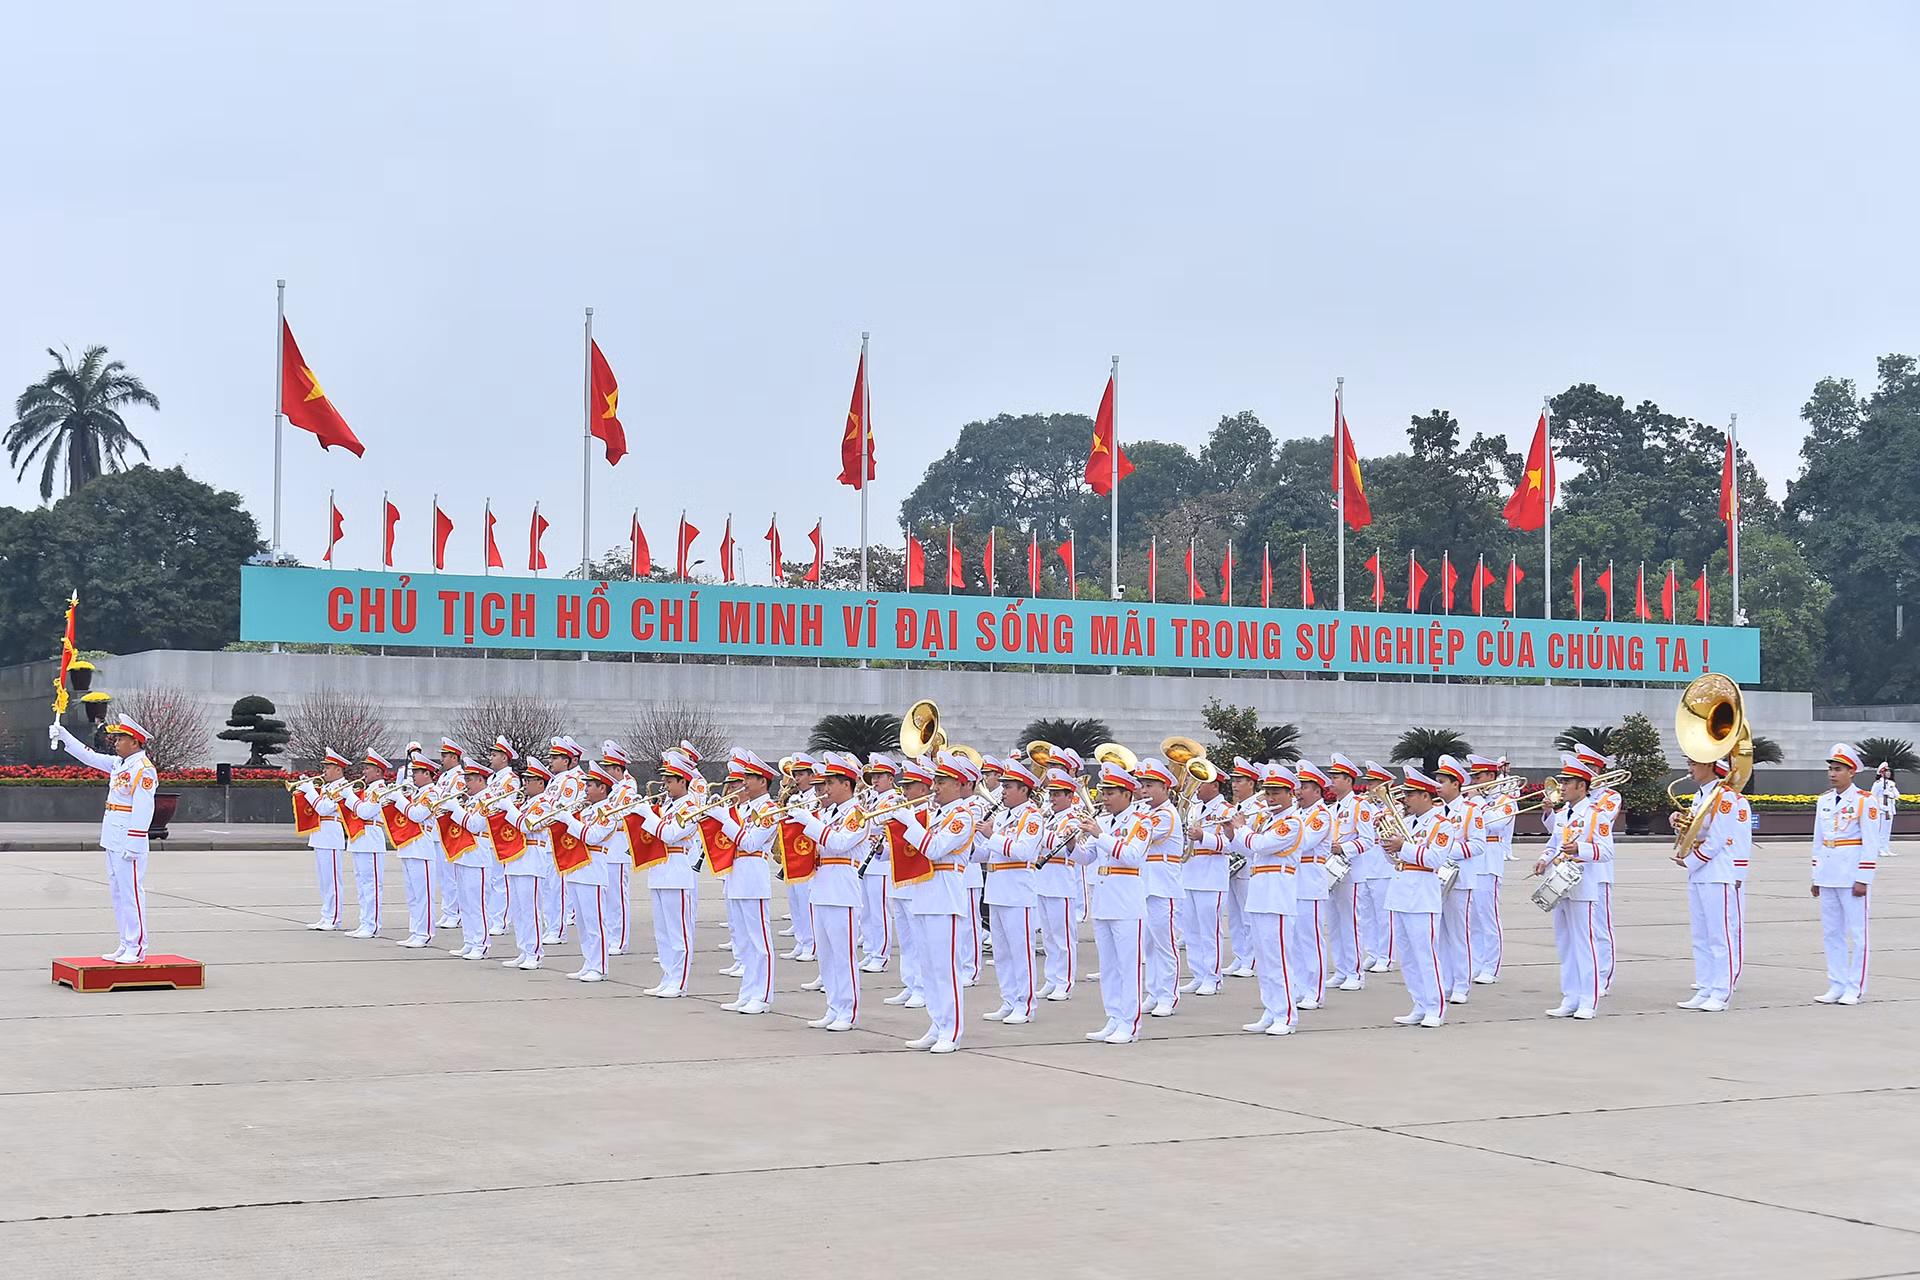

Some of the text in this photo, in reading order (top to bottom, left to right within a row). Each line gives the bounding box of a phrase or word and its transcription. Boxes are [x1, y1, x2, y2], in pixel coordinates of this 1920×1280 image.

[327, 575, 416, 633] CHỦ
[437, 589, 537, 646] TỊCH
[557, 581, 611, 638] HỒ
[631, 591, 701, 643] CHÍ
[719, 601, 823, 647] MINH
[843, 599, 878, 650] VĨ
[895, 607, 959, 659] ĐẠI
[975, 599, 1074, 654] SỐNG
[1091, 609, 1157, 657] MÃI
[1171, 617, 1282, 662] TRONG
[1295, 619, 1341, 669] SỰ
[1351, 621, 1465, 672] NGHIỆP
[1477, 619, 1535, 668] CỦA
[1547, 627, 1645, 672] CHÚNG
[1655, 637, 1689, 674] TA
